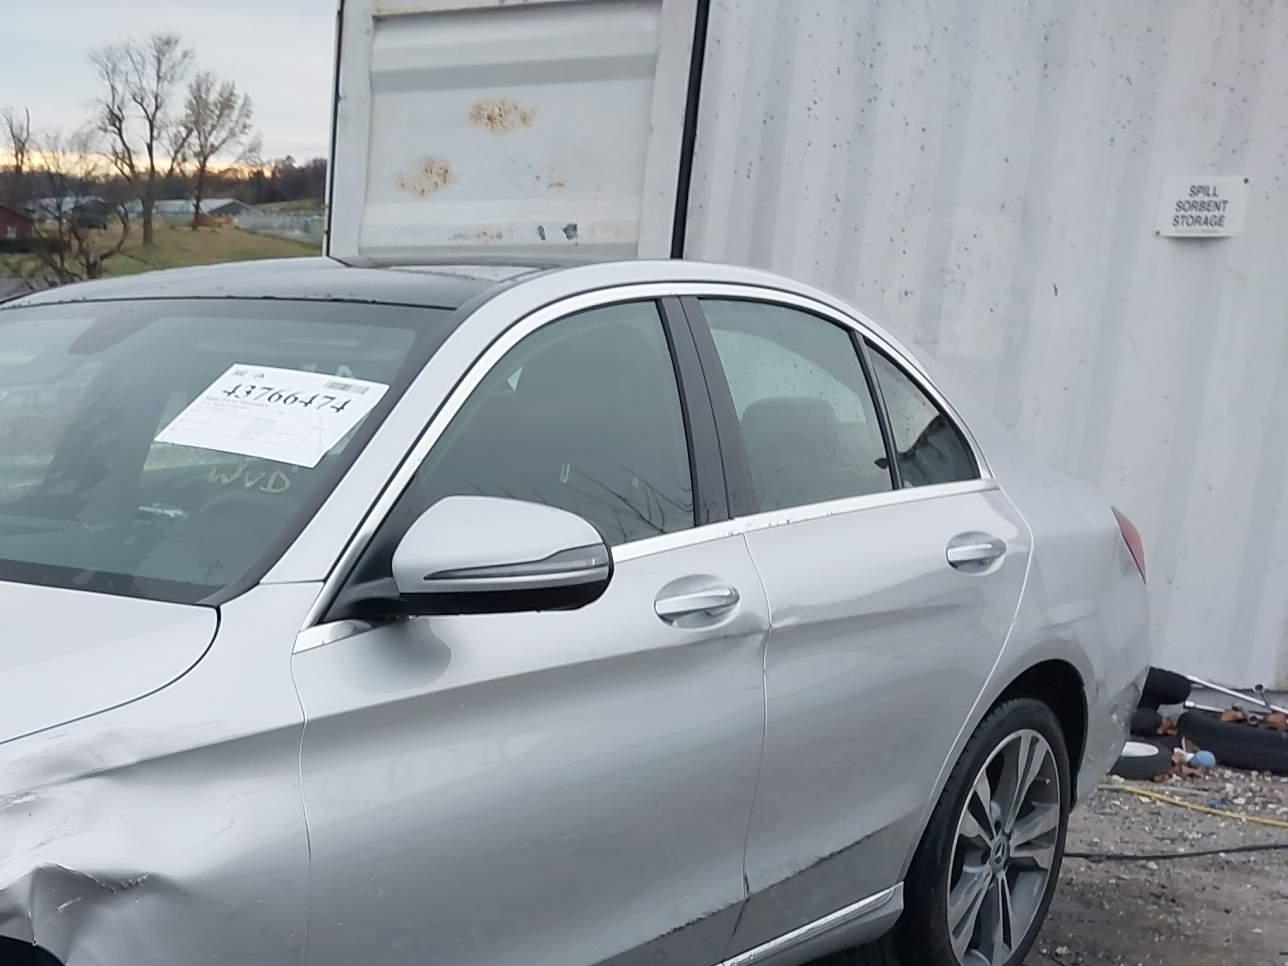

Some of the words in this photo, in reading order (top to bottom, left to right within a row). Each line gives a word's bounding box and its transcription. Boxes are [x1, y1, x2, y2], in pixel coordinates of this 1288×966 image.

[1189, 185, 1219, 198] SPILL
[1175, 200, 1229, 213] SORBENT
[1172, 214, 1226, 228] STORAGE
[222, 383, 353, 413] 43766474
